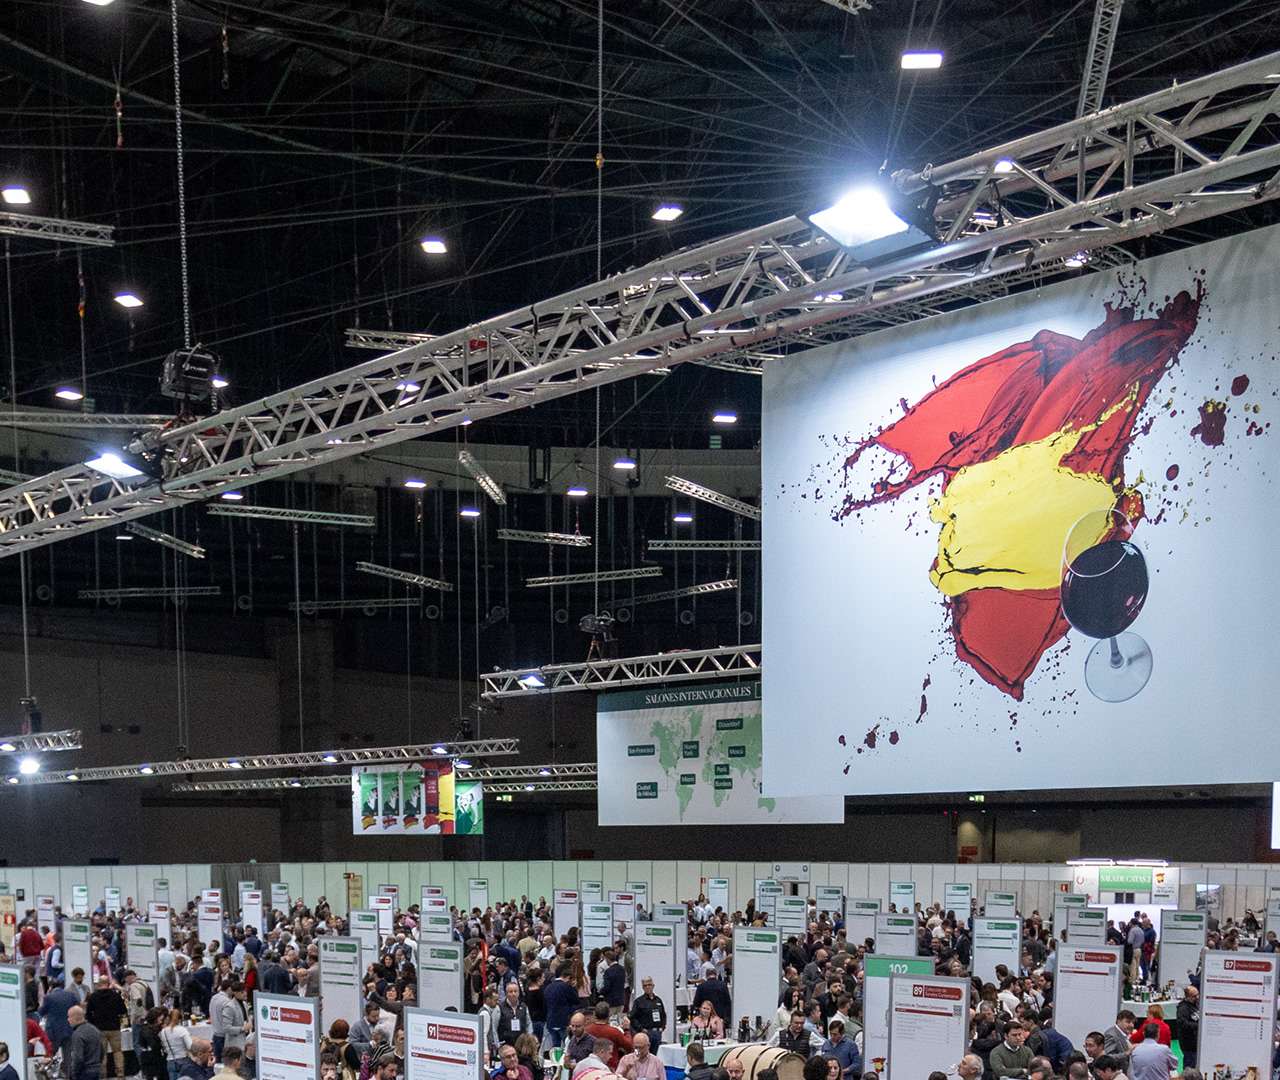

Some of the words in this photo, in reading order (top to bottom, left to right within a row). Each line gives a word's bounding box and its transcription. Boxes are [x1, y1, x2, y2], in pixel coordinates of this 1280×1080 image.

[645, 692, 679, 704] SALONES
[679, 686, 751, 701] INTERNACIONALES
[889, 964, 908, 974] 102
[914, 987, 923, 995] 89
[429, 1026, 436, 1037] 91
